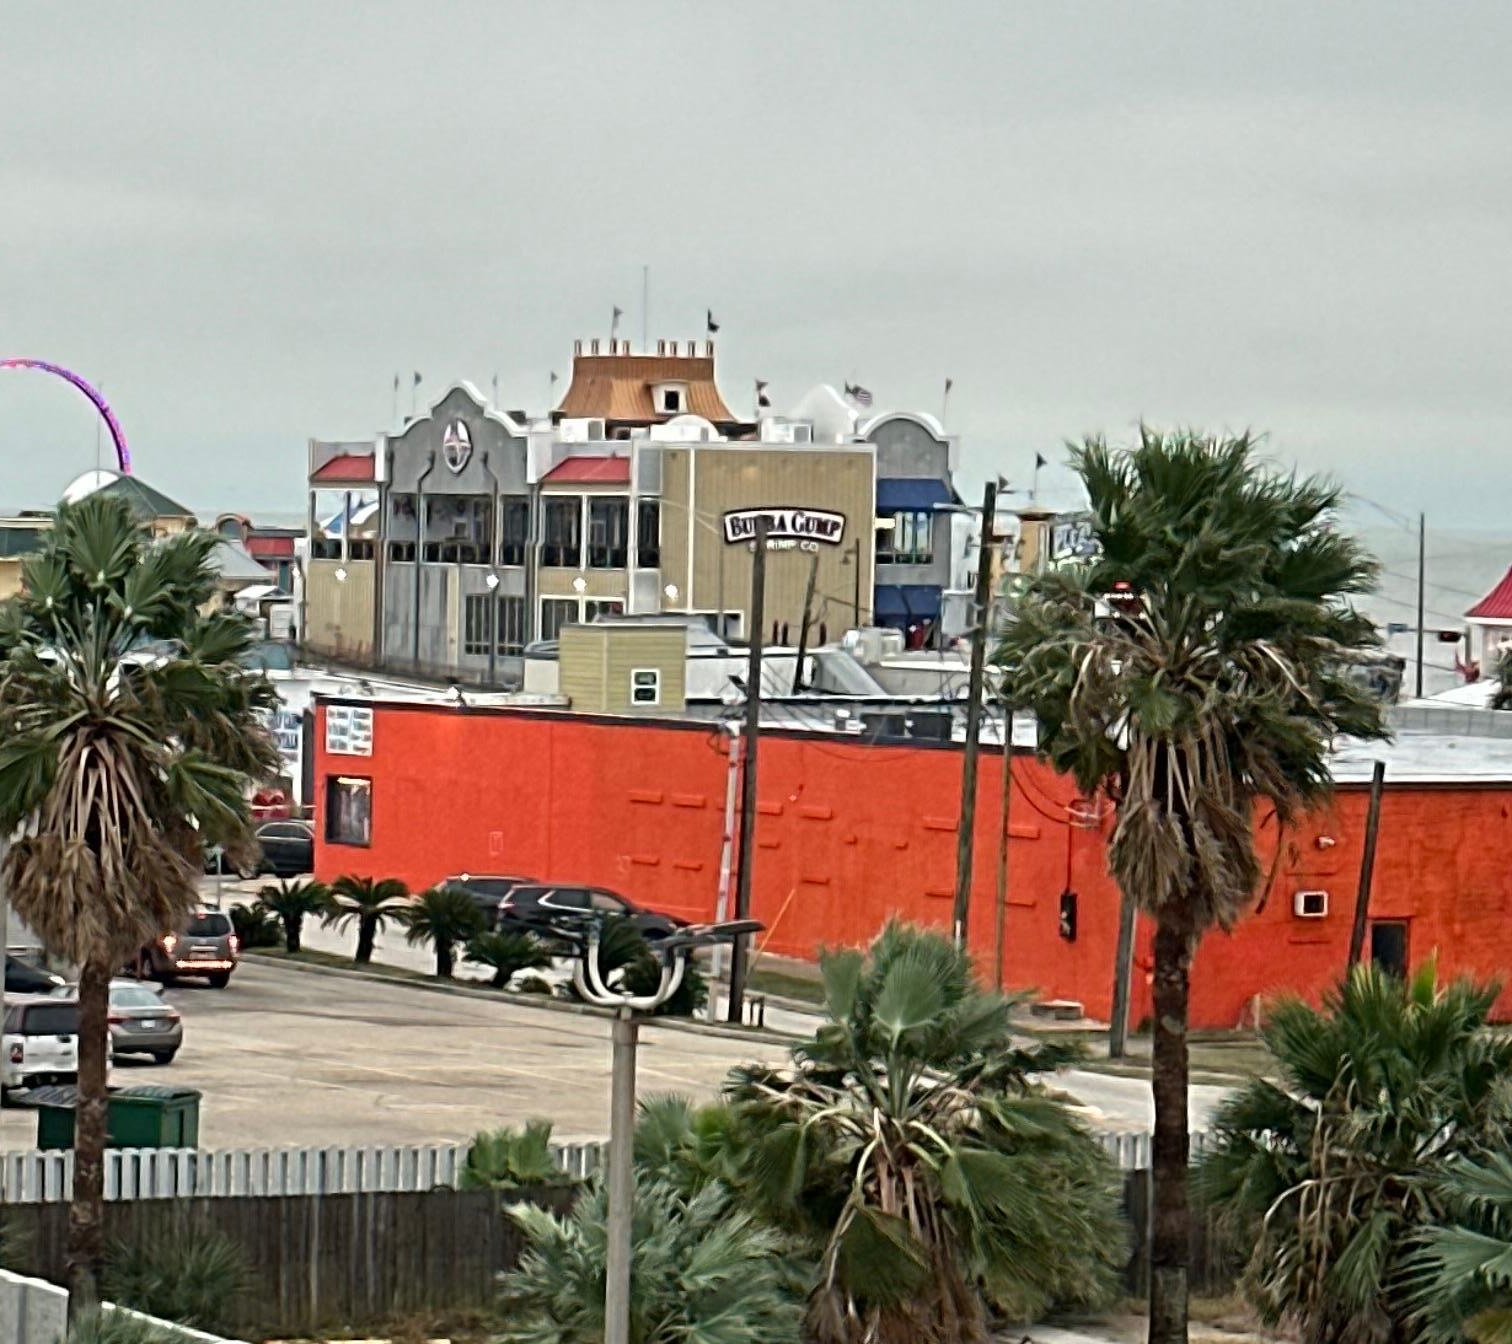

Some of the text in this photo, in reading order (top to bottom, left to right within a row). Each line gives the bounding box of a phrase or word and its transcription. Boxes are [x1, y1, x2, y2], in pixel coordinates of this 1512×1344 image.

[729, 511, 842, 537] BUBA GUMP
[748, 539, 797, 552] SRIMP
